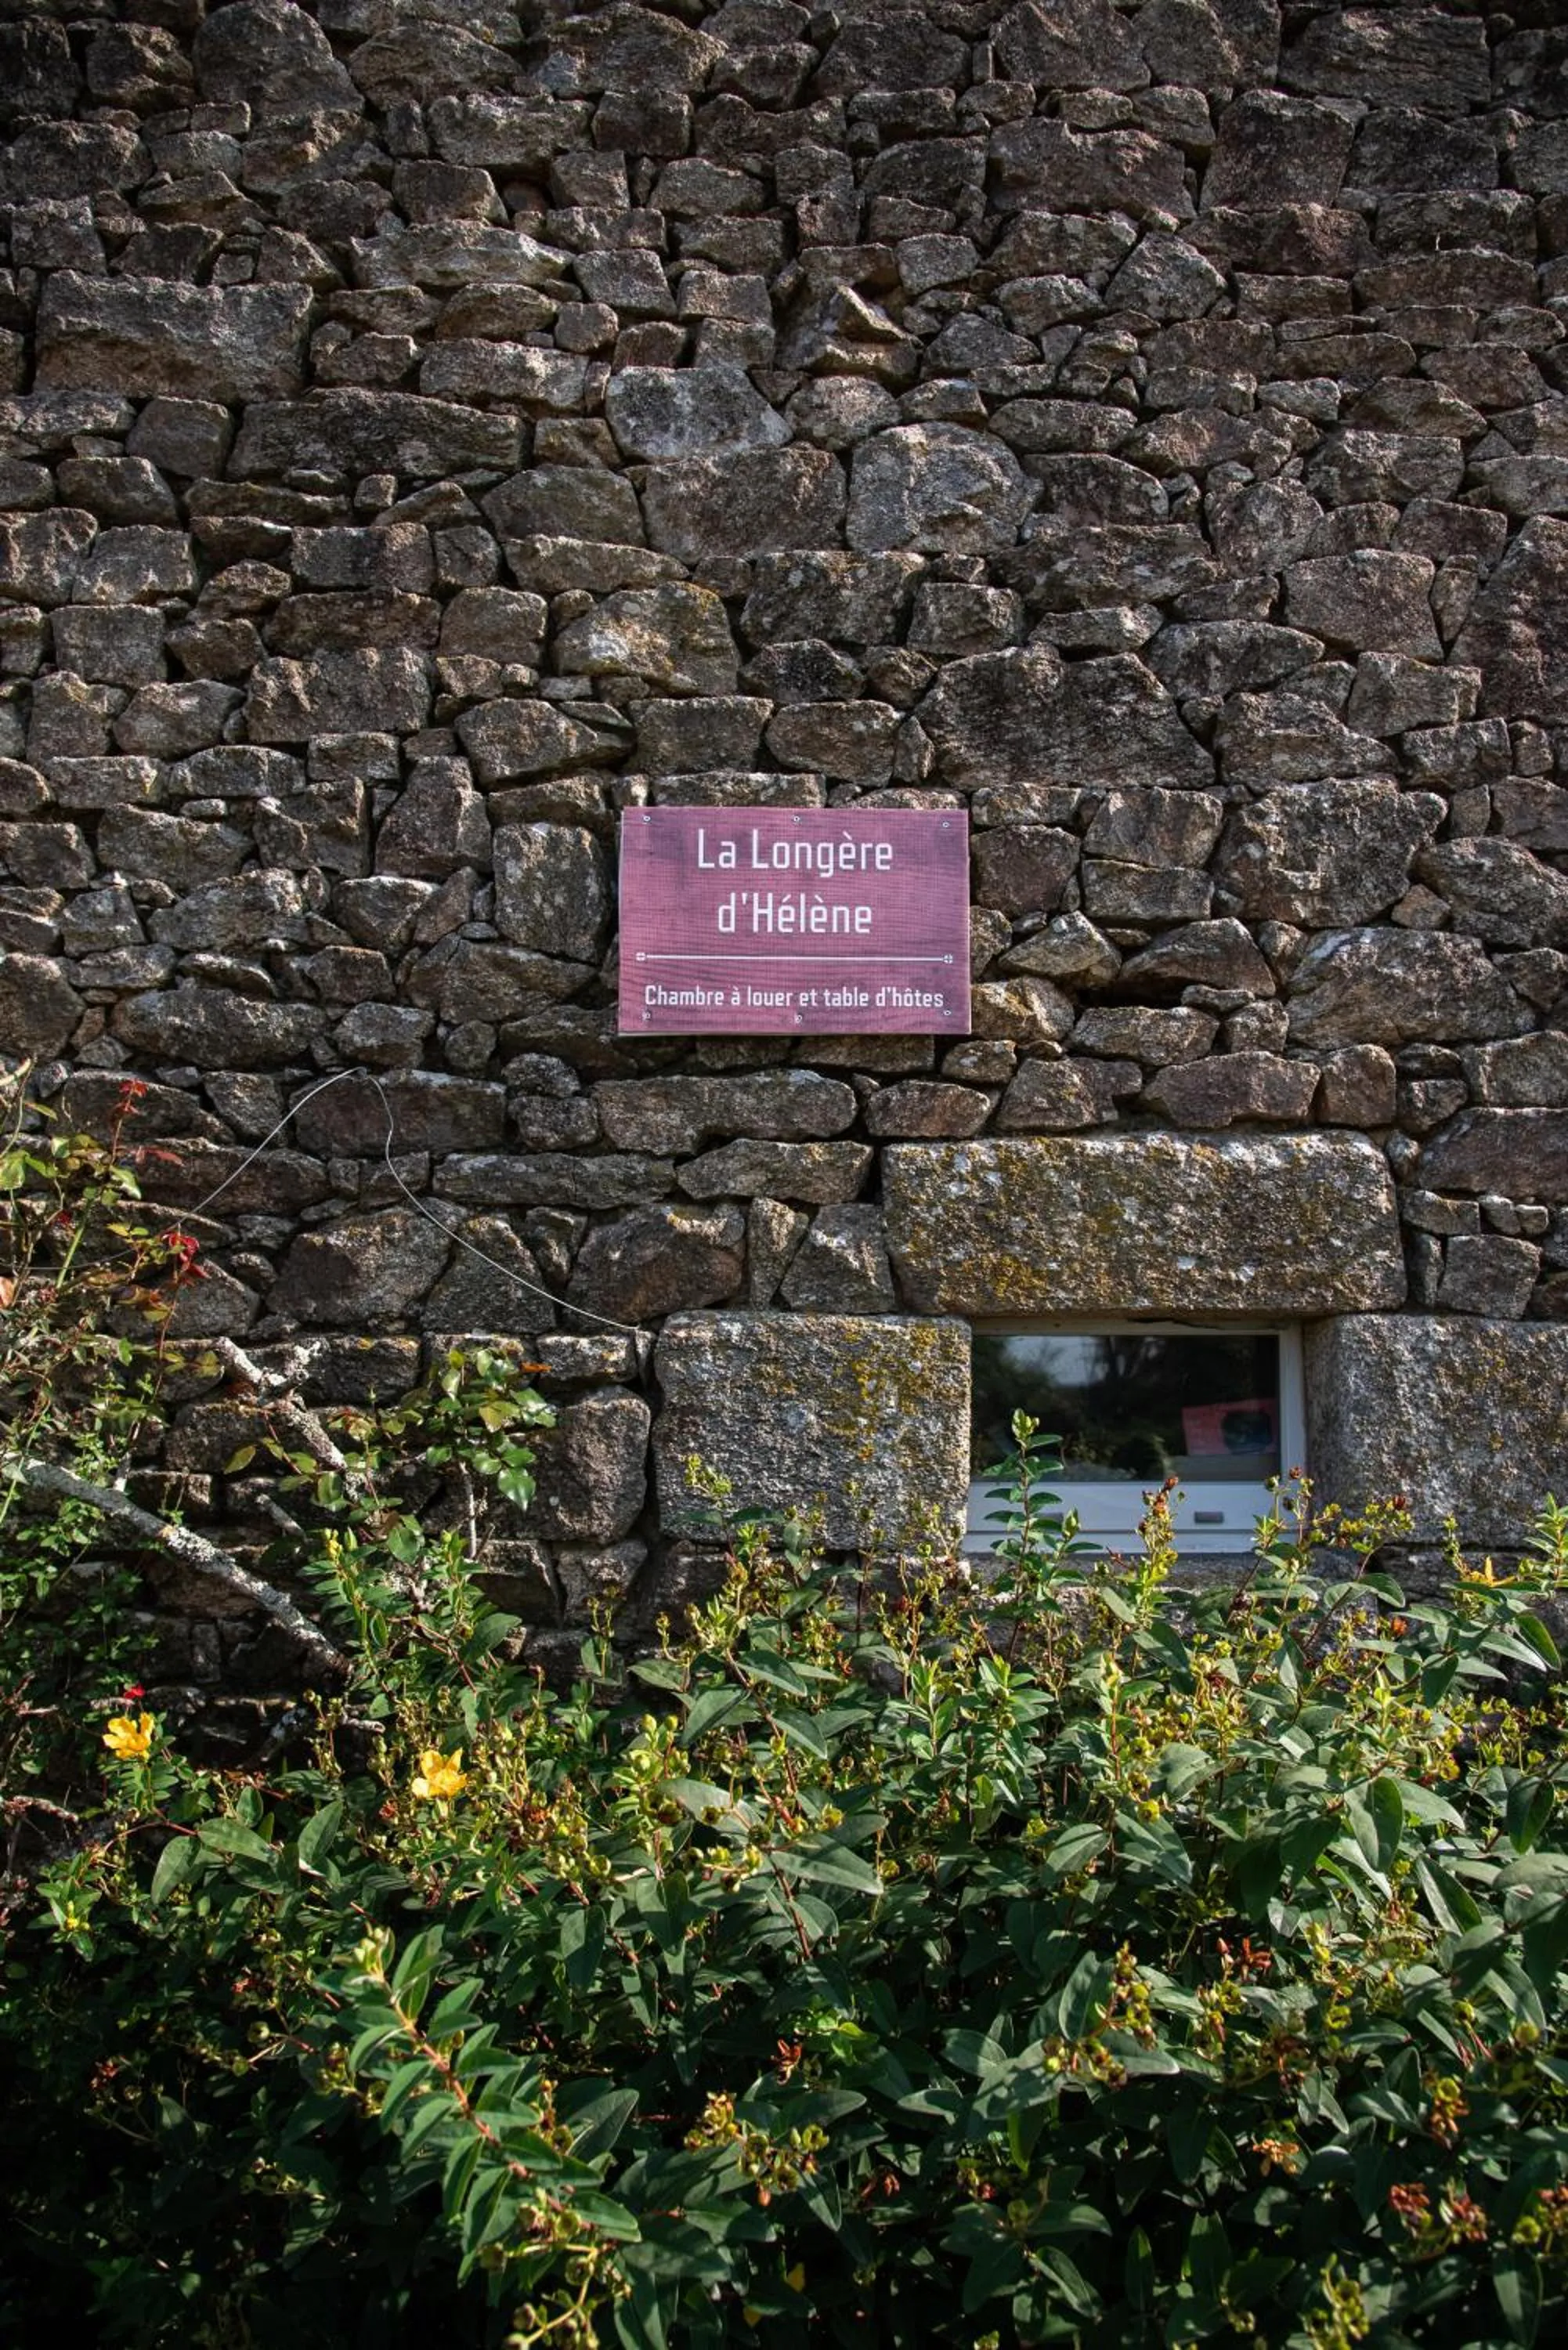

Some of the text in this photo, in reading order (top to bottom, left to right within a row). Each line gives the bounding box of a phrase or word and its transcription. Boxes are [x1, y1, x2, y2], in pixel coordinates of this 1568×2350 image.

[697, 828, 893, 879] La Longère
[717, 891, 873, 935] d'Hélène
[645, 985, 944, 1008] Chambre à louer et table d'hôtes
